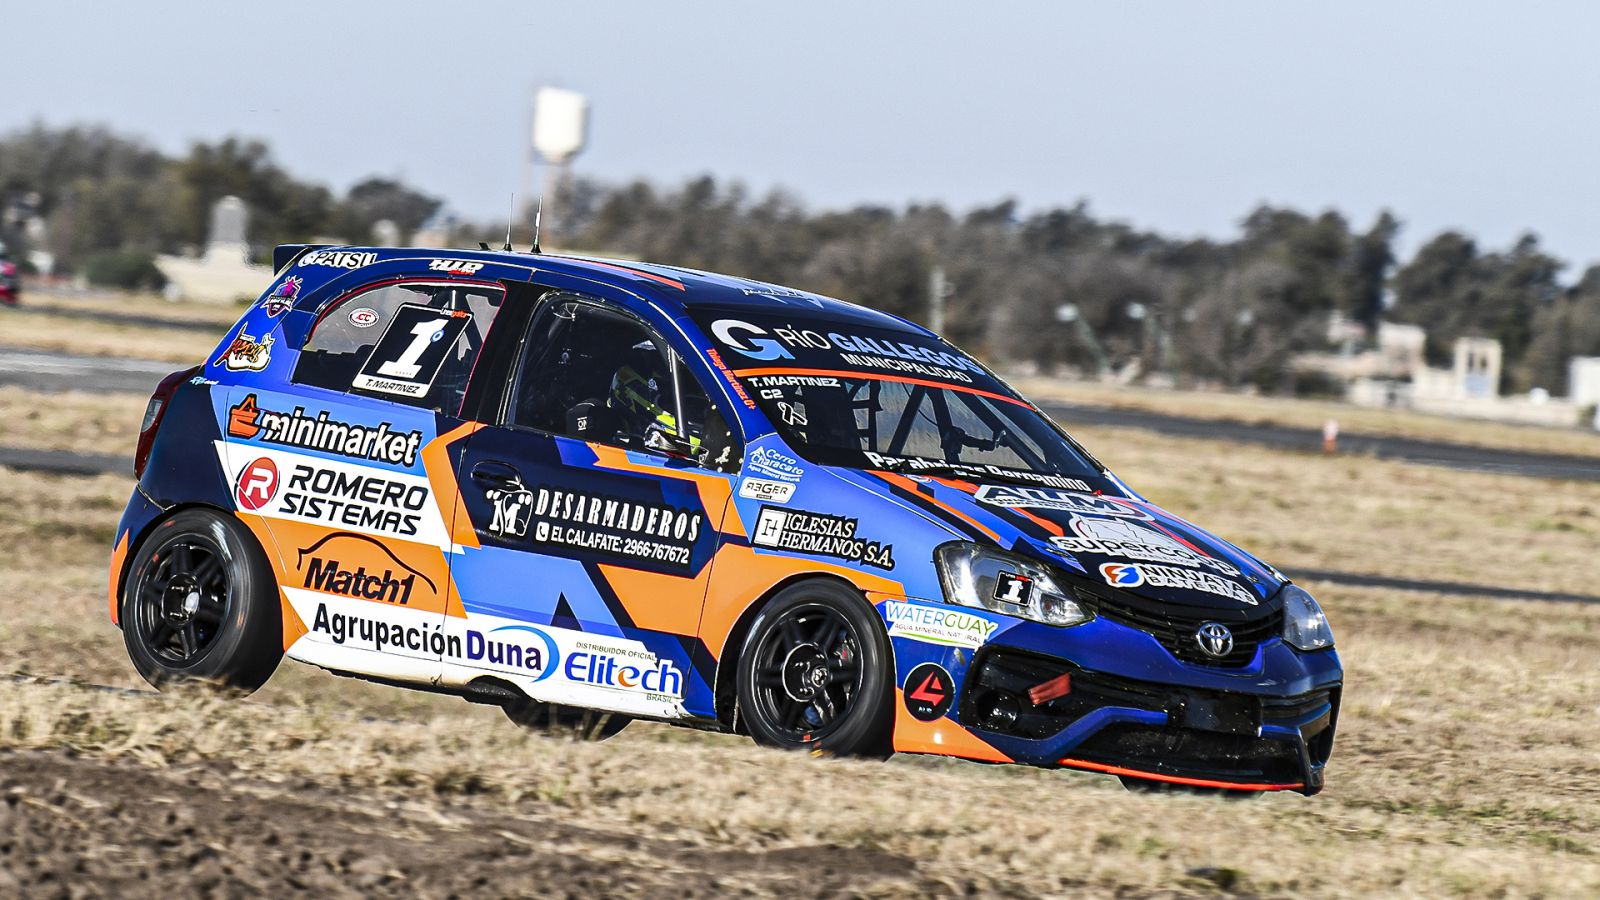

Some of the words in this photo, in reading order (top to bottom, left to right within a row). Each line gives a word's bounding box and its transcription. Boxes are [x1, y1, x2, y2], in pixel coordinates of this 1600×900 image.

[773, 324, 831, 350] RÍO
[827, 332, 987, 376] GALLEGOS
[747, 377, 763, 388] T.
[764, 377, 841, 387] MARTINEZ
[839, 353, 973, 383] MUNICIPALIDAD
[365, 379, 373, 387] T.
[373, 380, 420, 394] MARTINEZ
[760, 388, 784, 400] C2
[261, 409, 421, 466] minimarket
[750, 454, 804, 475] Characato
[766, 449, 797, 465] Cerro
[288, 465, 429, 511] ROMERO
[279, 492, 421, 536] SISTEMAS
[535, 489, 701, 542] DESARMADEROS
[783, 513, 855, 538] IGLESIAS
[551, 526, 565, 542] EL
[566, 528, 623, 552] CALAFATE:
[623, 538, 689, 564] 2966-767672
[778, 531, 863, 559] HERMANOS
[864, 548, 893, 567] S.A.
[303, 557, 415, 604] Match1
[1141, 565, 1249, 594] NINJATA
[1150, 576, 1257, 604] BATERIAS
[886, 603, 995, 636] WATERGUAY
[894, 623, 914, 632] AGUA
[914, 626, 945, 637] MINERAL
[313, 603, 462, 659] Agrupación
[466, 630, 541, 671] Duna
[576, 641, 626, 656] DISTRIBUIDOR
[627, 650, 656, 661] OFICIAL
[564, 652, 680, 694] Elitech
[646, 693, 673, 704] BRASIL
